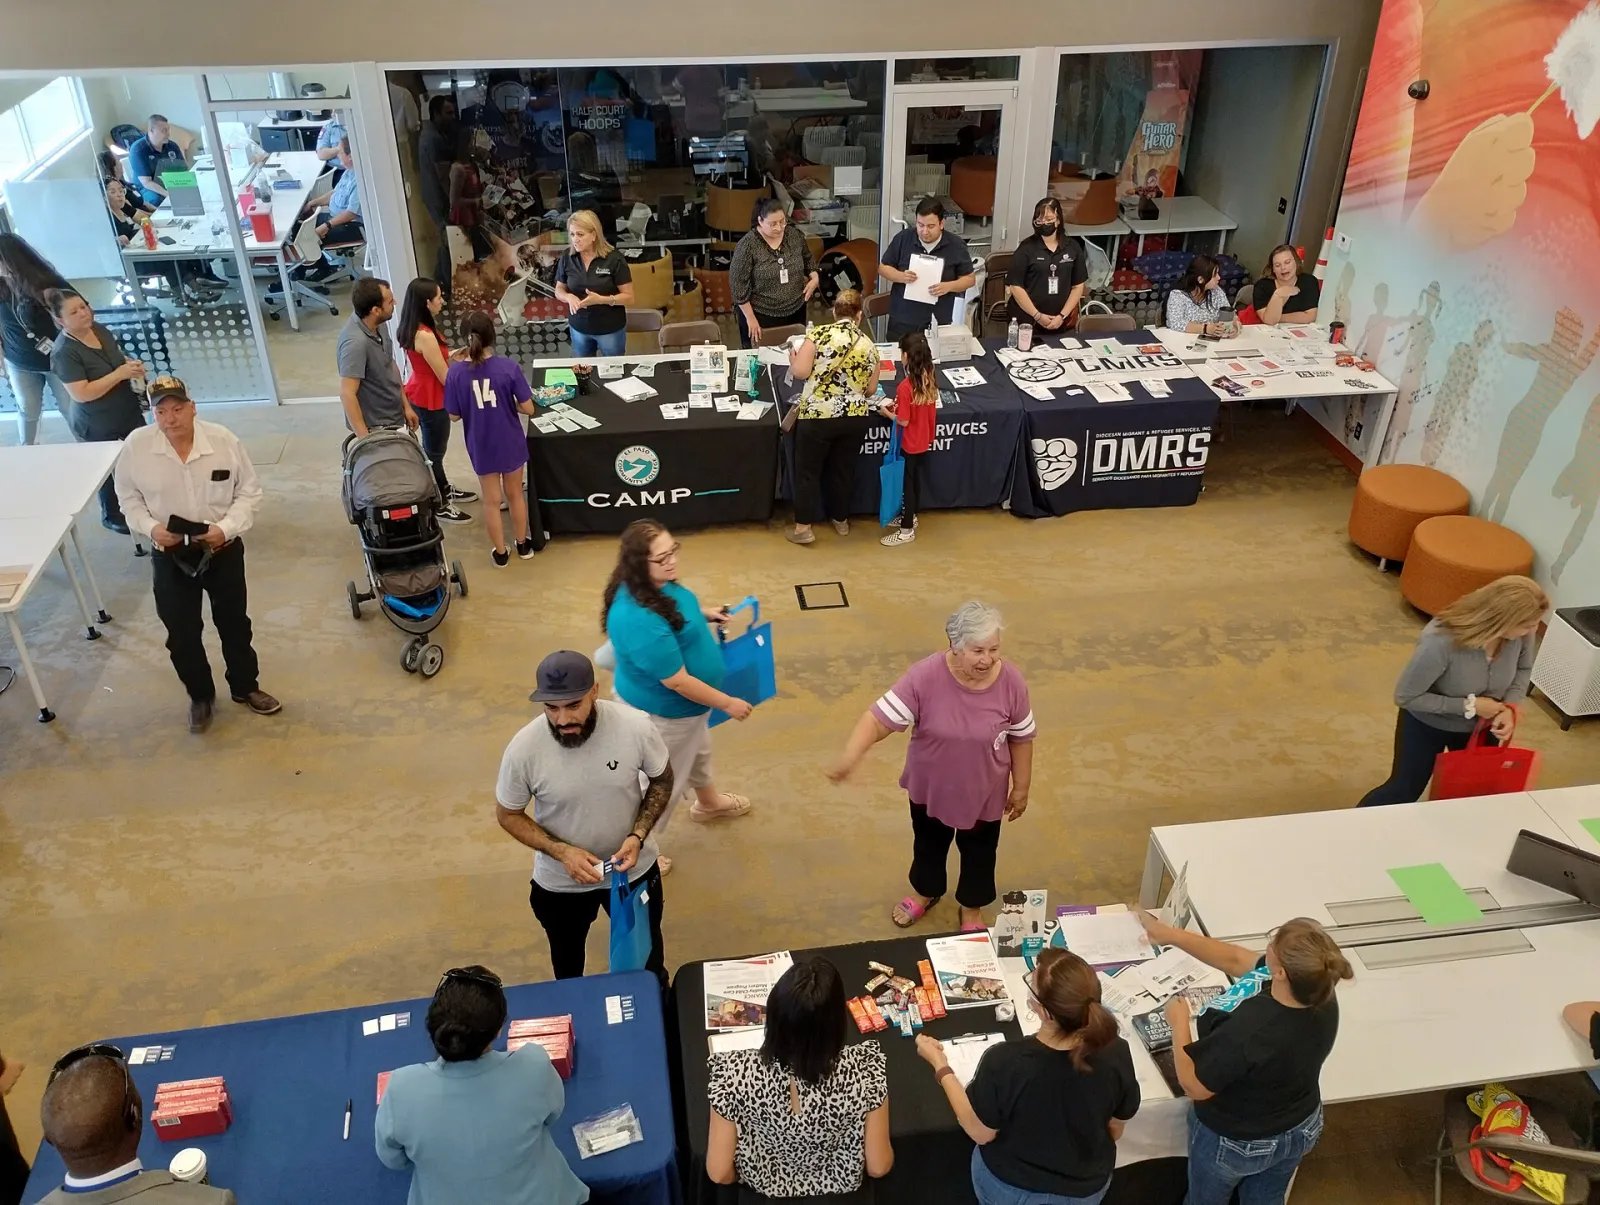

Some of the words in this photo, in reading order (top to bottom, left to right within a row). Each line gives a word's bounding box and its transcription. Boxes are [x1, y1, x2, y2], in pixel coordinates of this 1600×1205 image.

[572, 106, 593, 116] HALF
[596, 105, 625, 115] COURT
[579, 118, 621, 130] HOOPS
[472, 378, 497, 409] 14
[935, 422, 988, 437] RVICES
[1096, 431, 1121, 439] DIOCESAN
[633, 447, 650, 455] PASO
[1092, 432, 1211, 473] DMRS
[617, 459, 643, 484] COMMUNITY
[587, 487, 692, 508] CAMP
[1145, 1022, 1167, 1031] CAREE
[1147, 1026, 1173, 1035] TECHNIC
